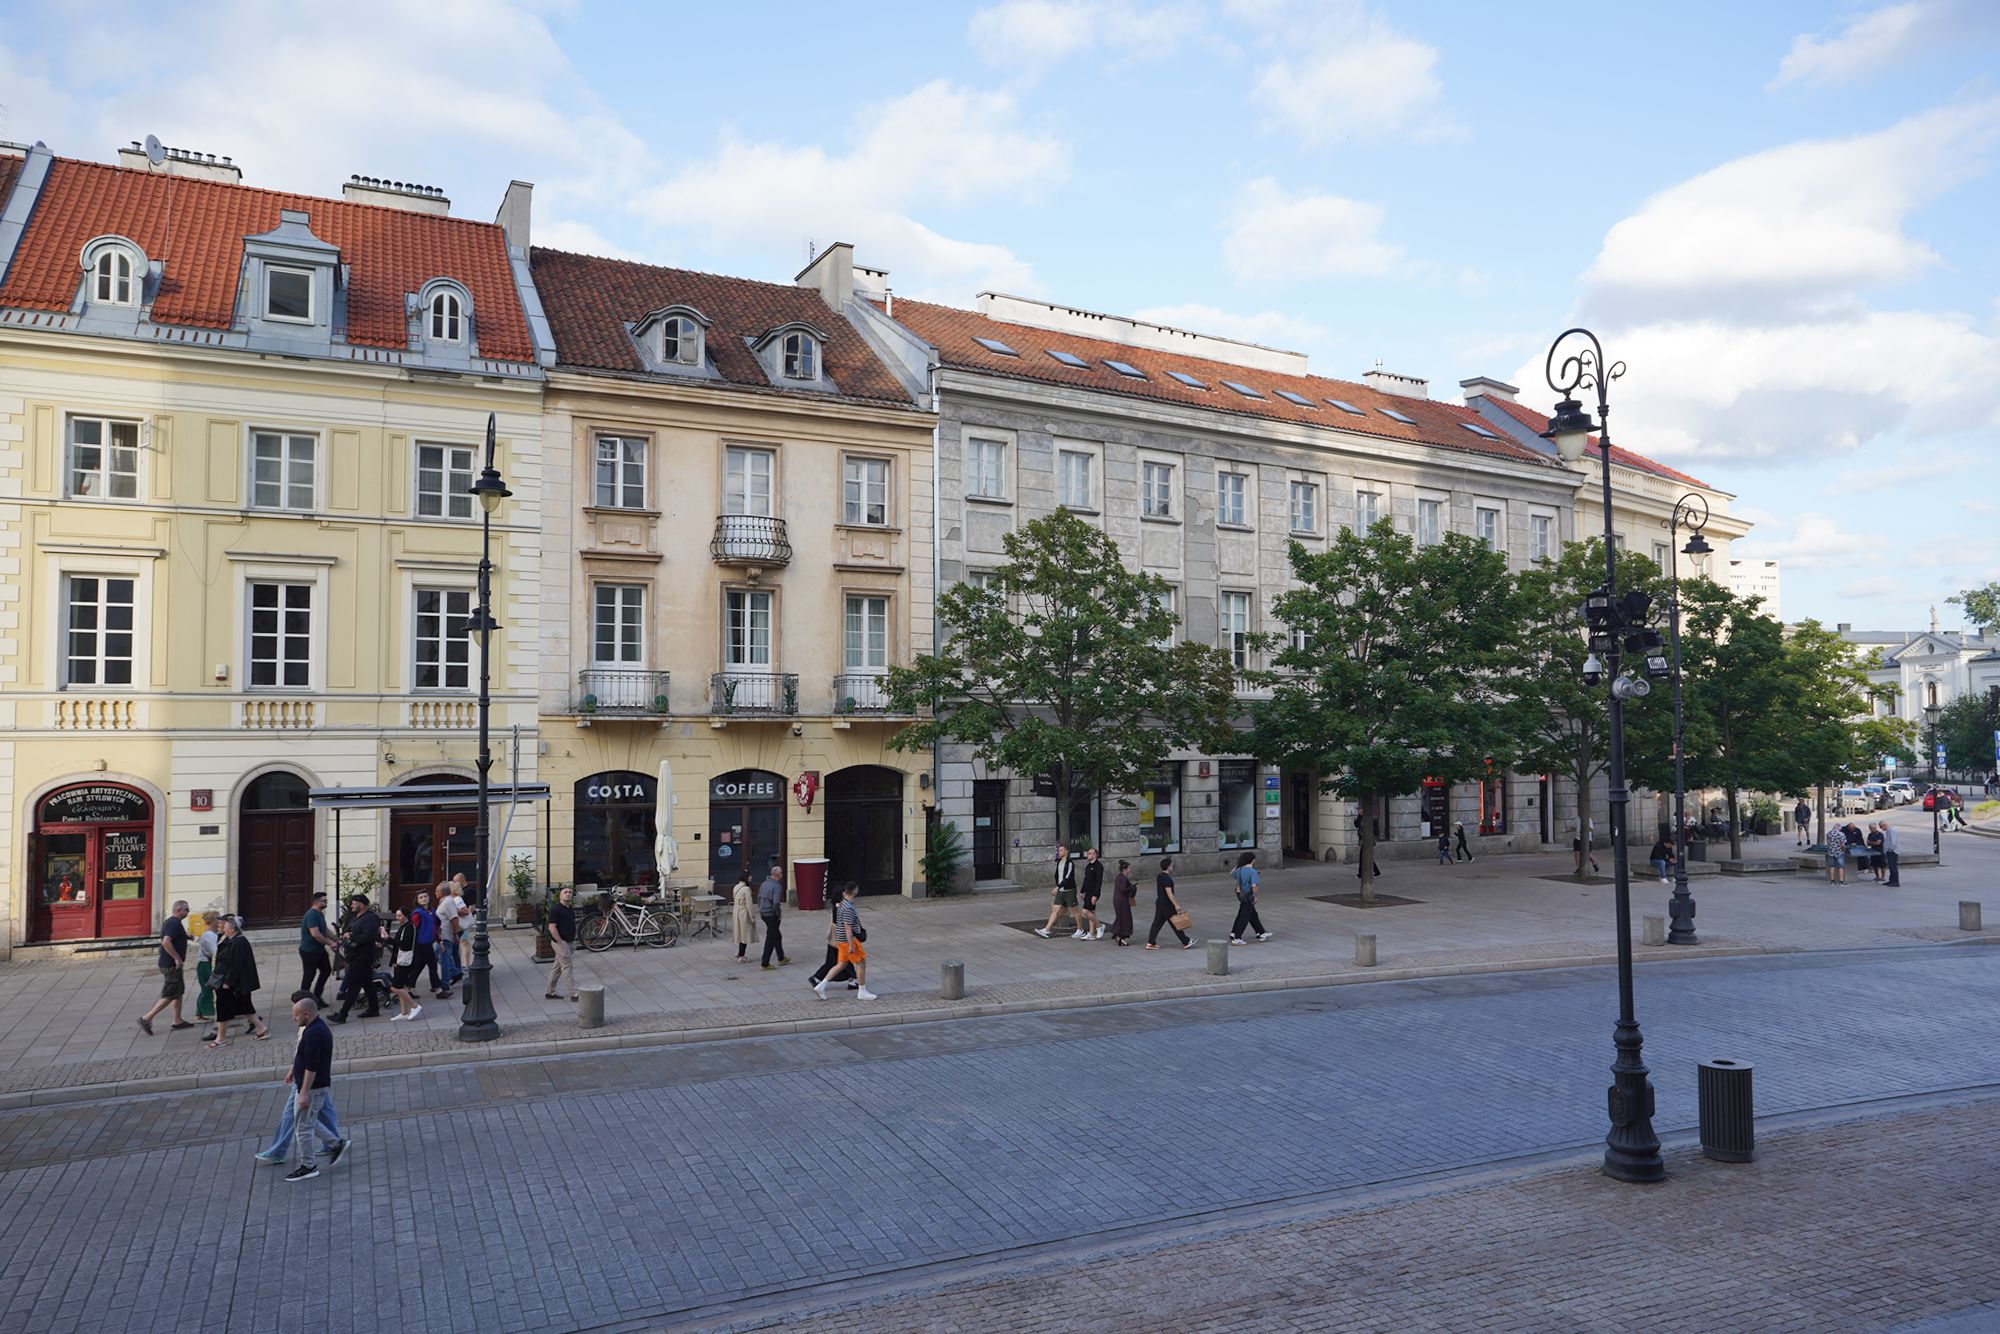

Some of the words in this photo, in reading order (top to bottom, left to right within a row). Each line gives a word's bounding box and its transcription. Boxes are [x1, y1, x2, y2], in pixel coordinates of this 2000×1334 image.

[587, 784, 645, 799] COSTA
[715, 782, 775, 796] COFFEE
[48, 788, 89, 807] PRACOWNIA
[90, 787, 145, 806] ARTYSTYCZNYCH
[67, 796, 84, 805] RAM
[86, 794, 126, 805] STYLOWYCH
[195, 796, 208, 807] 10
[113, 836, 139, 845] RAMY
[105, 843, 147, 853] STYLOWE
